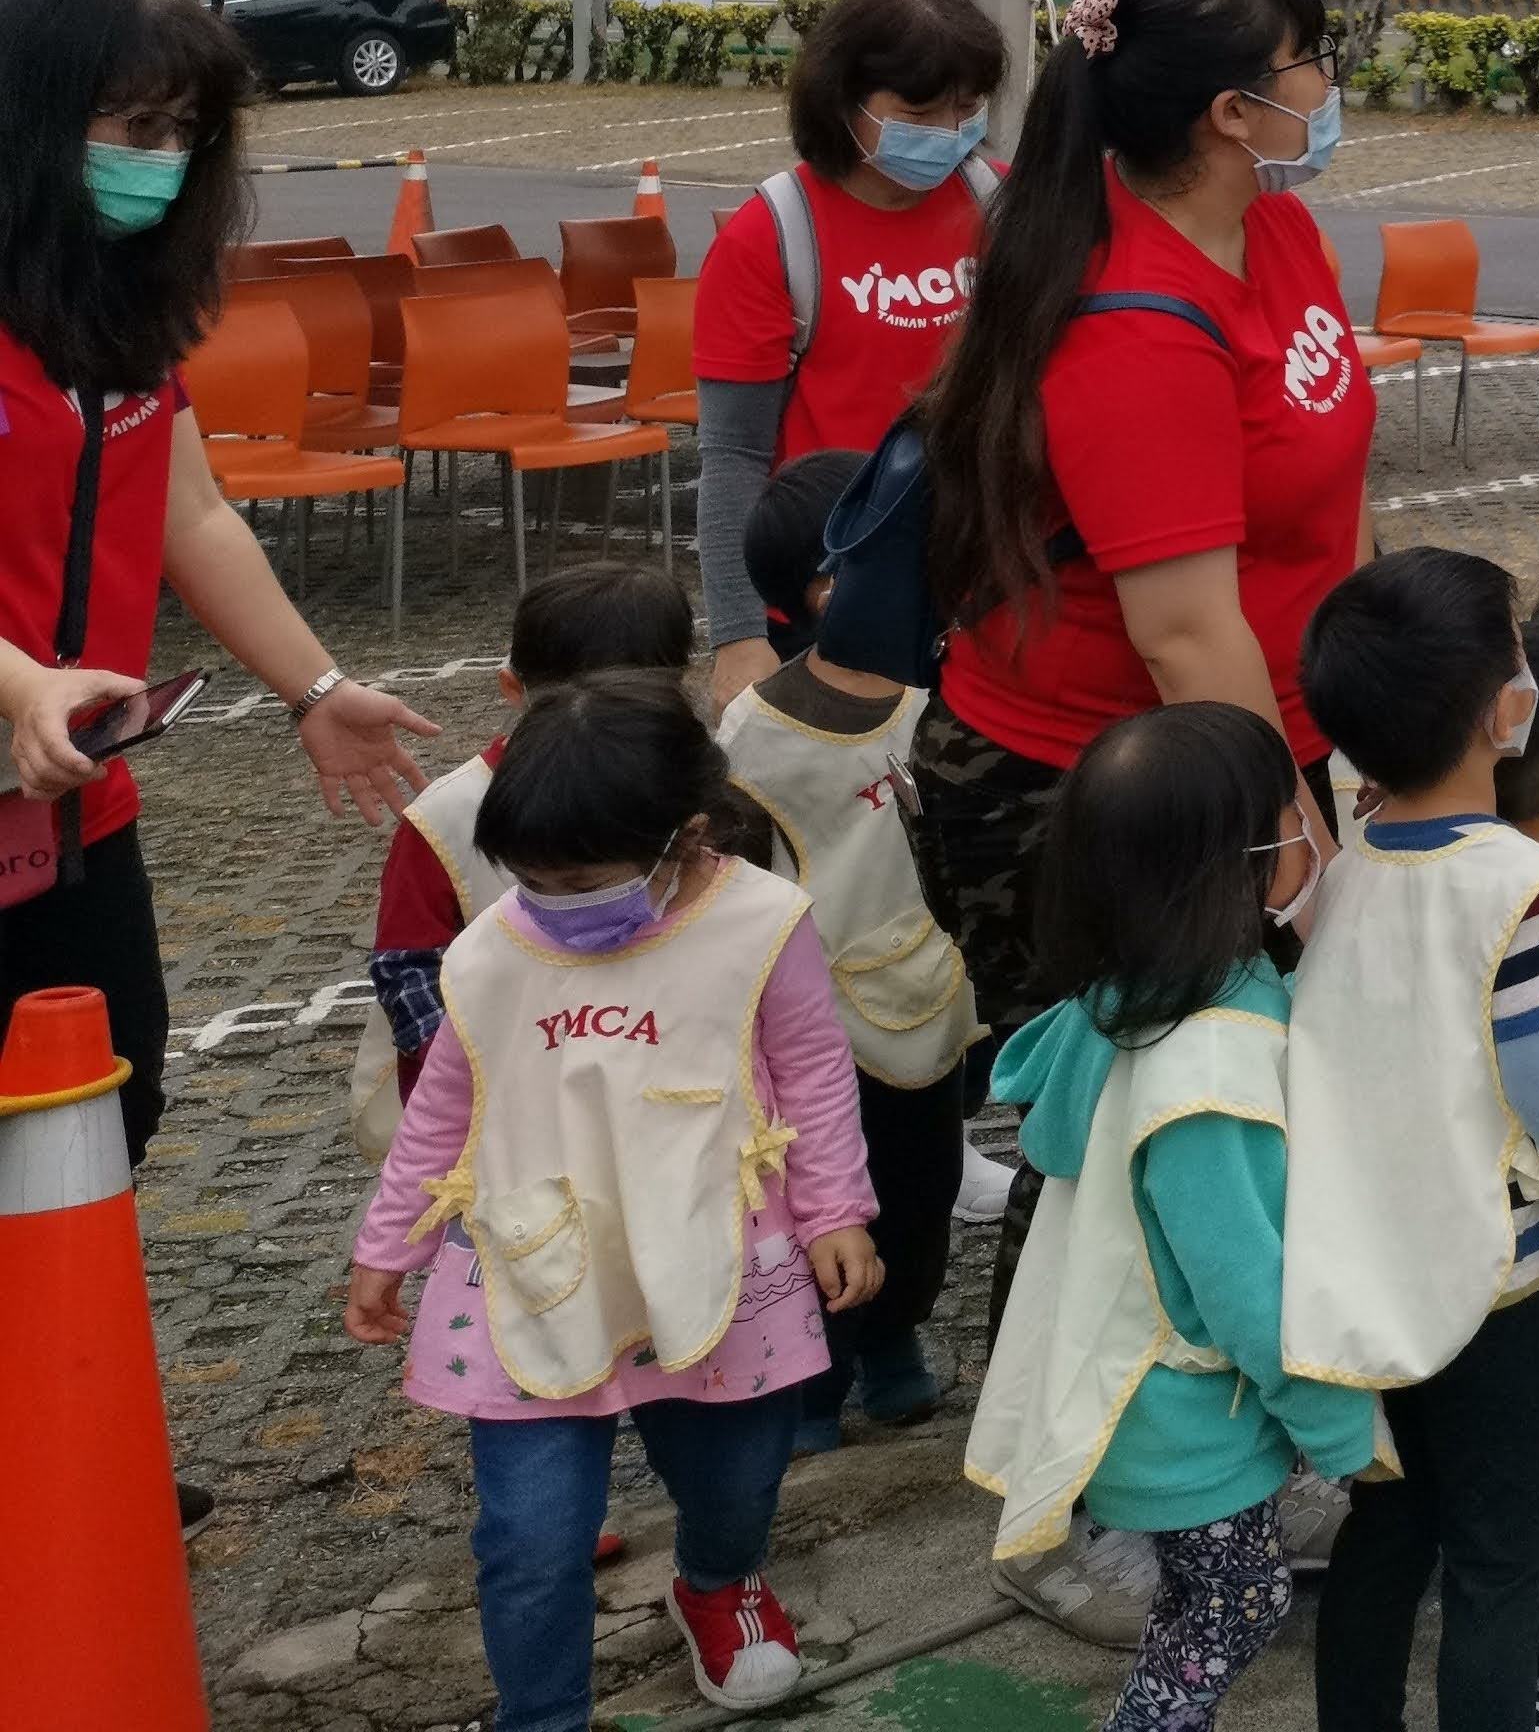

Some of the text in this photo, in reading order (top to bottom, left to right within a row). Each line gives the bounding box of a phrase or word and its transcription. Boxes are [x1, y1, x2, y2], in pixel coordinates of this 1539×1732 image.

[878, 309, 927, 328] TAINAN
[103, 396, 160, 441] AIWAN
[535, 1004, 660, 1051] YMCA
